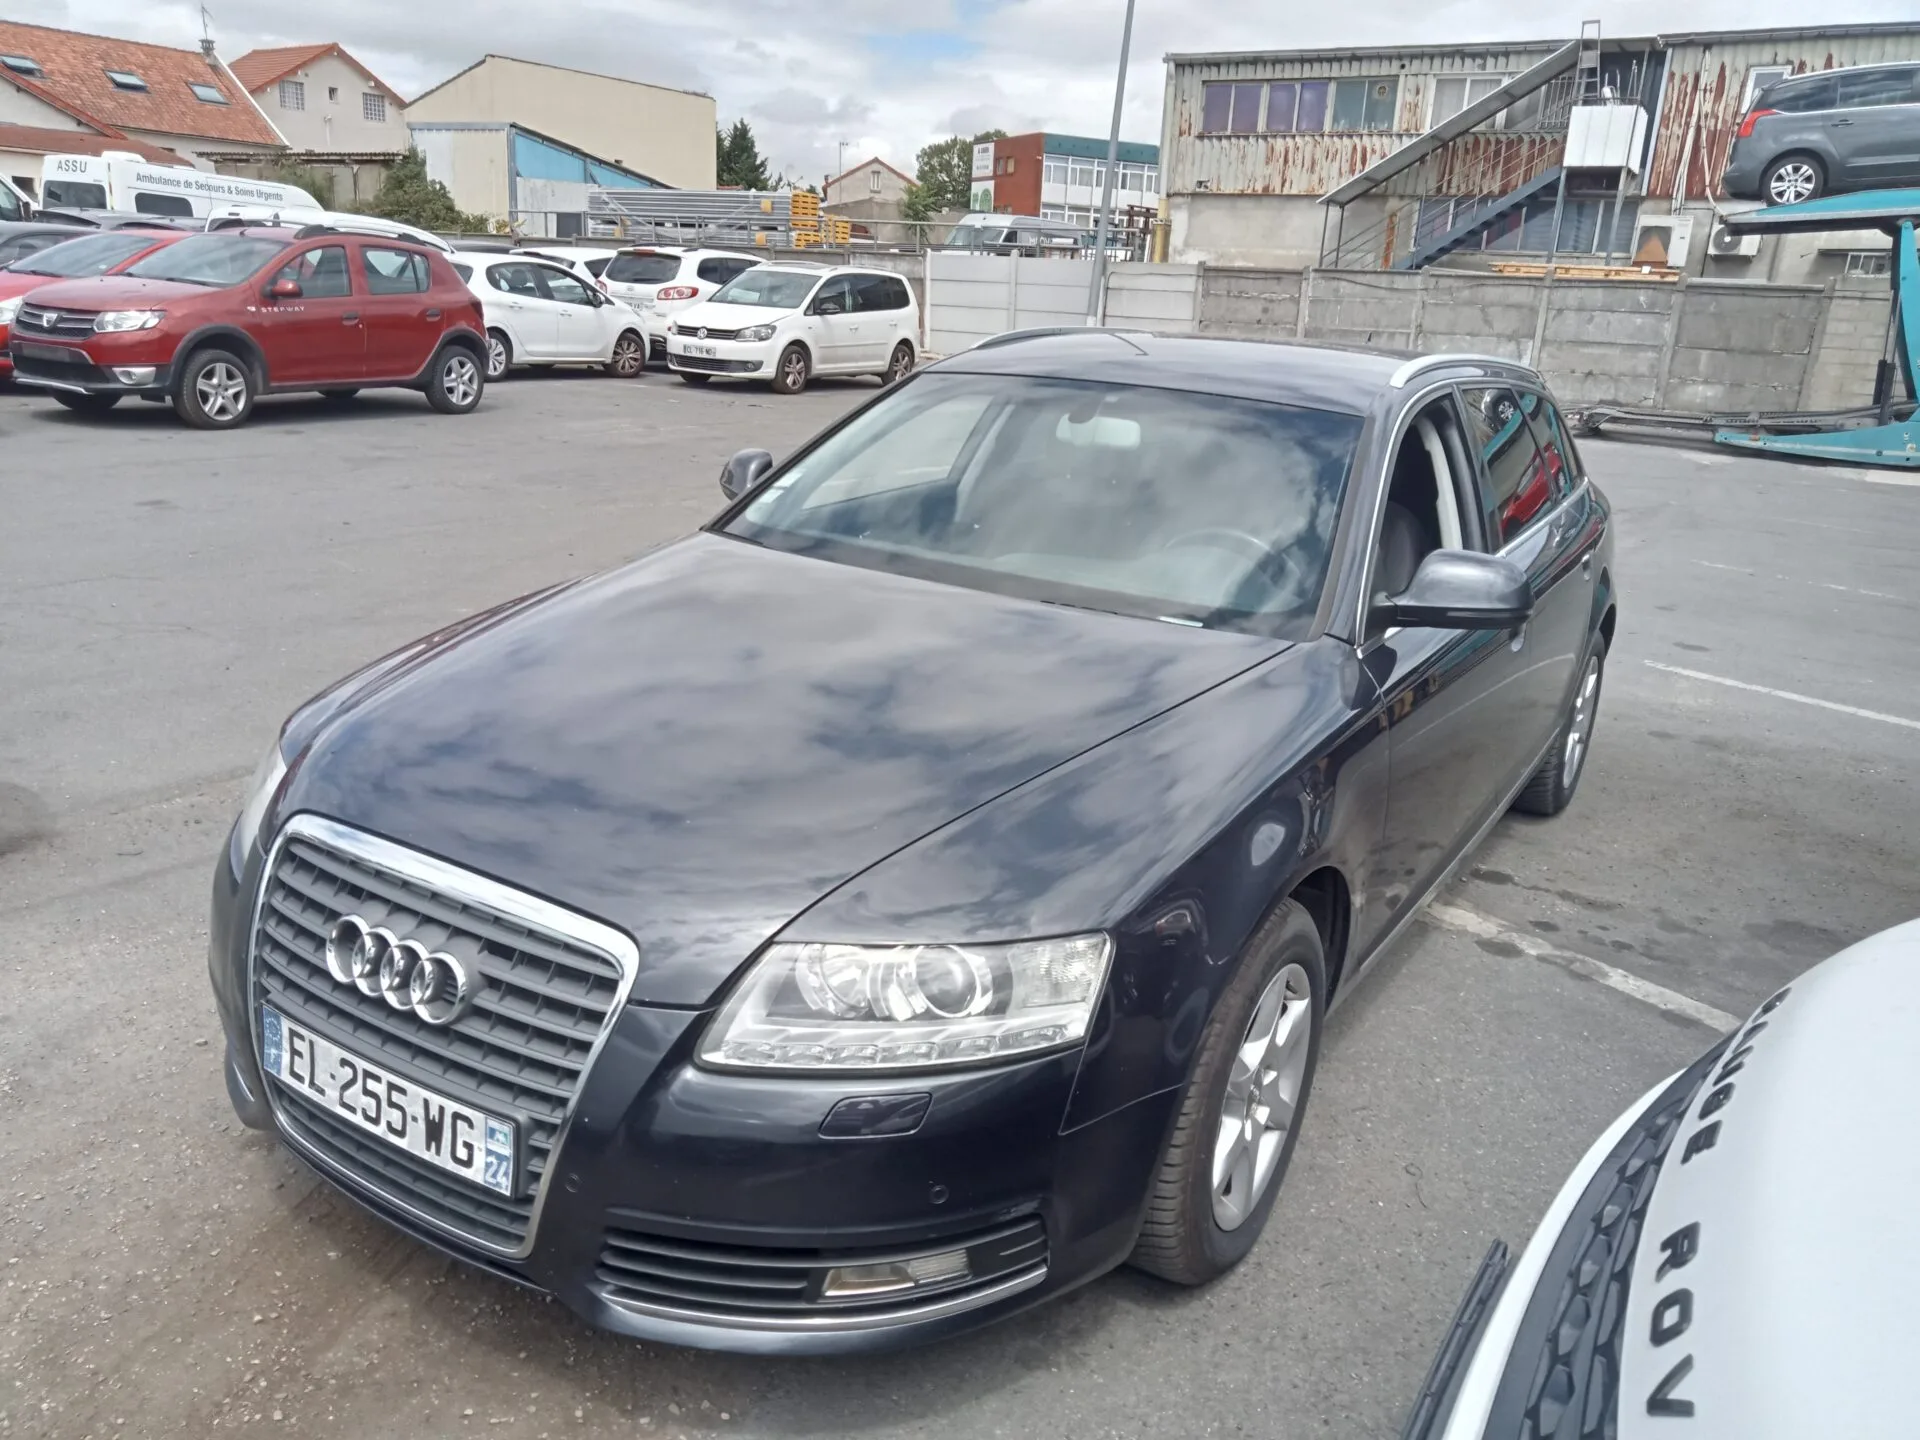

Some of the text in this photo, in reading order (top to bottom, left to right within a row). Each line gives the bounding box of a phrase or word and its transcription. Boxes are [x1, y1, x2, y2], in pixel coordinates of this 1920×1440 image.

[57, 159, 88, 173] ASSU
[136, 172, 283, 201] Ambulance de Secours & Soins Urgents
